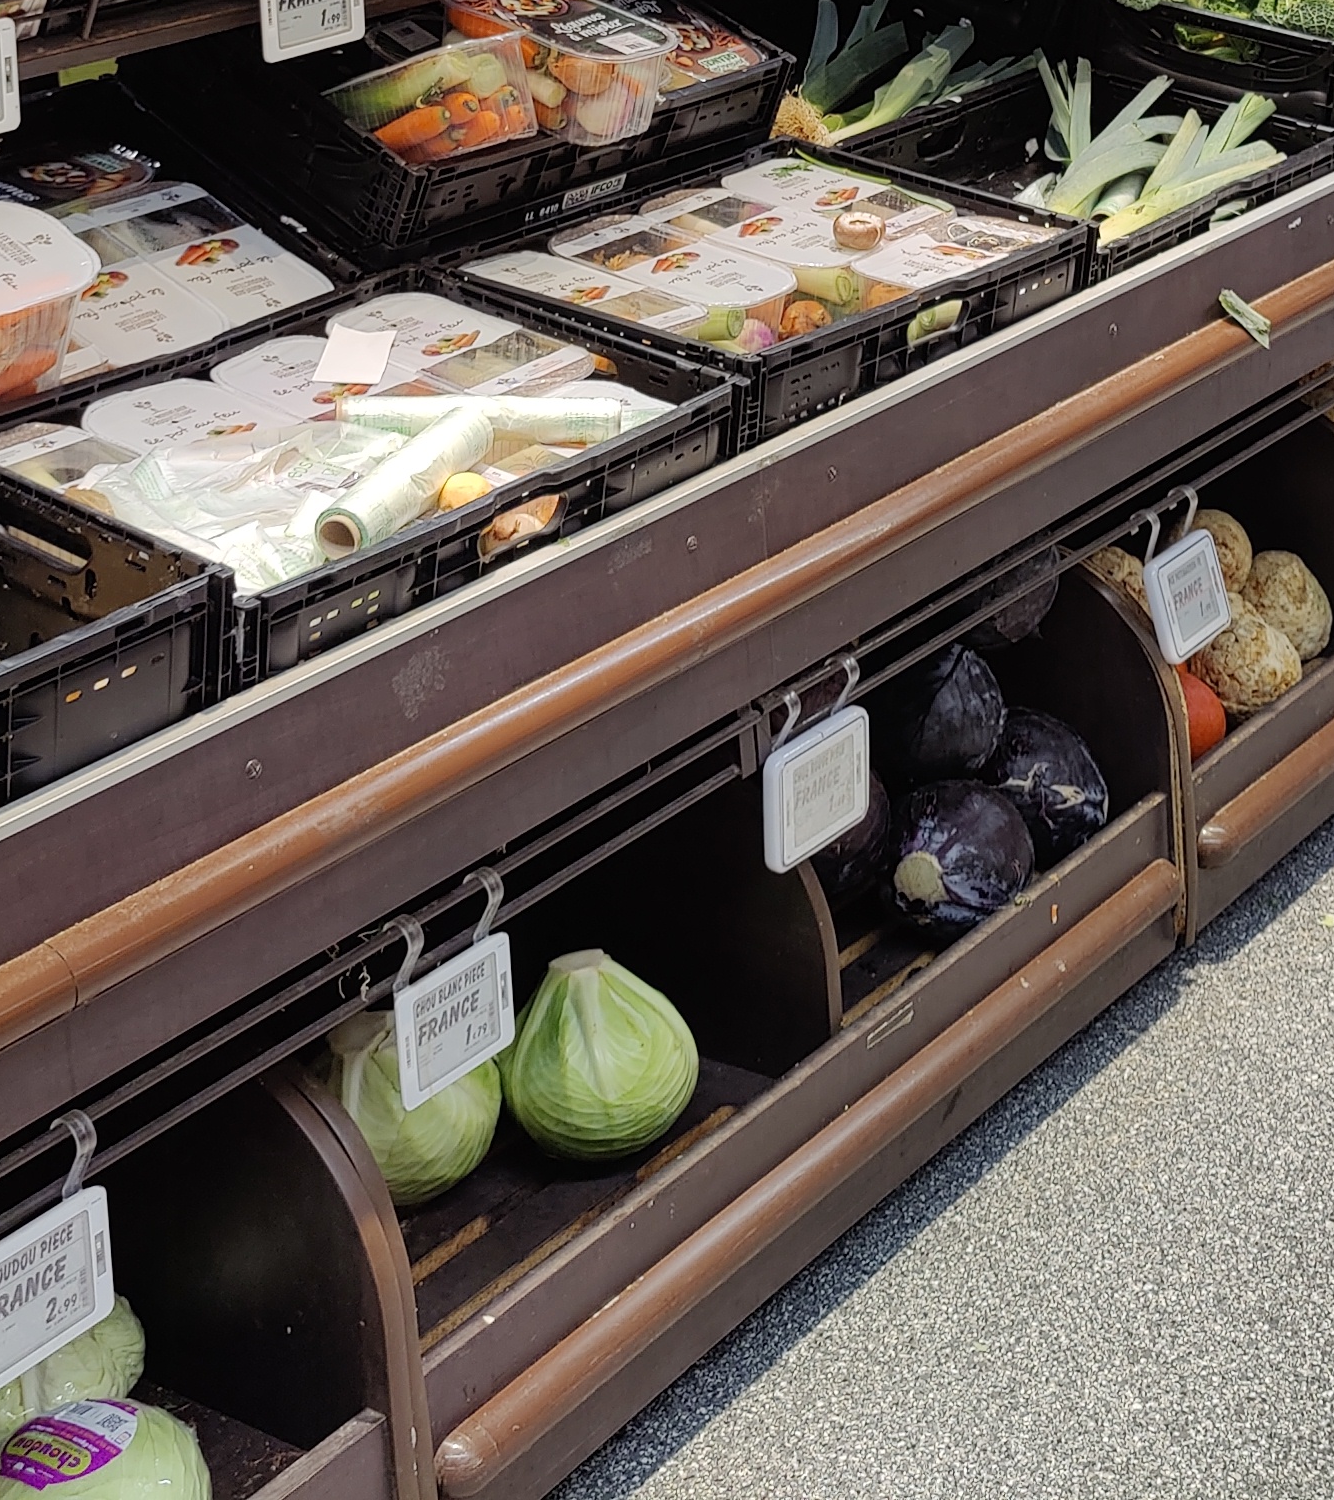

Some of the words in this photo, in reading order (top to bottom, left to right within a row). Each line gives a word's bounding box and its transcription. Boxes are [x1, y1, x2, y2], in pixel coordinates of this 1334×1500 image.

[591, 180, 613, 195] IFCO
[1173, 576, 1204, 612] FRANCE
[793, 764, 842, 810] FRANCE
[416, 997, 437, 1019] CHOU
[438, 977, 463, 1003] BLANC
[464, 961, 486, 988] PIECE
[418, 988, 481, 1046] FRANCE
[40, 1221, 75, 1259] PIECE
[12, 1438, 82, 1469] choudou
